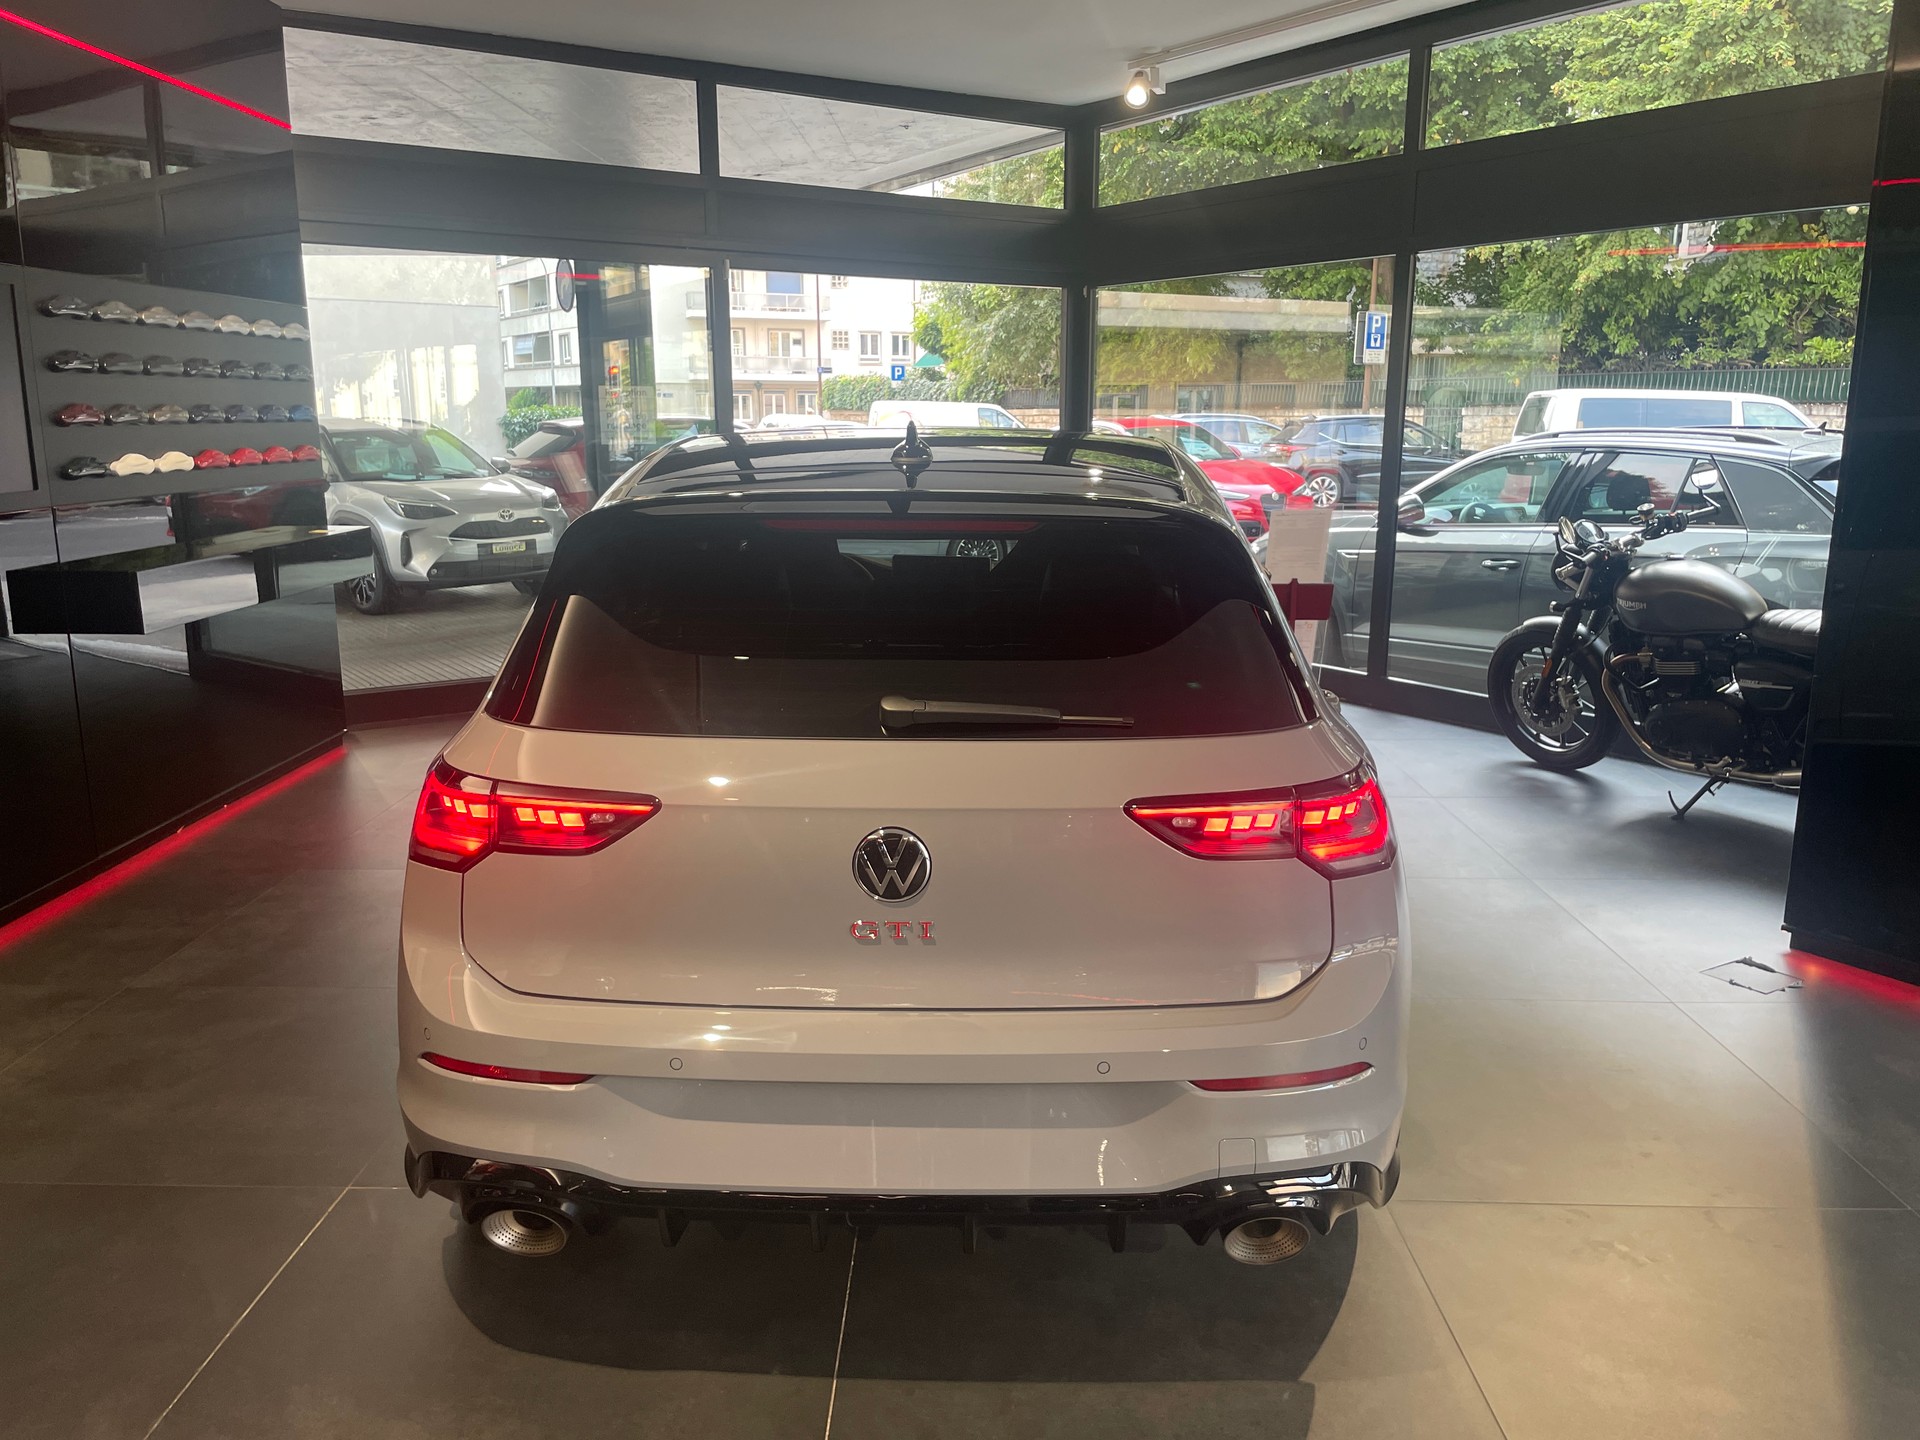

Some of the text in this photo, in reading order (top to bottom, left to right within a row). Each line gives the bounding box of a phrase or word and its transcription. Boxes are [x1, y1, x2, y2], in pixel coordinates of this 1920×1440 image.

[1372, 315, 1381, 334] P
[894, 366, 903, 380] P
[851, 919, 935, 940] GTI
